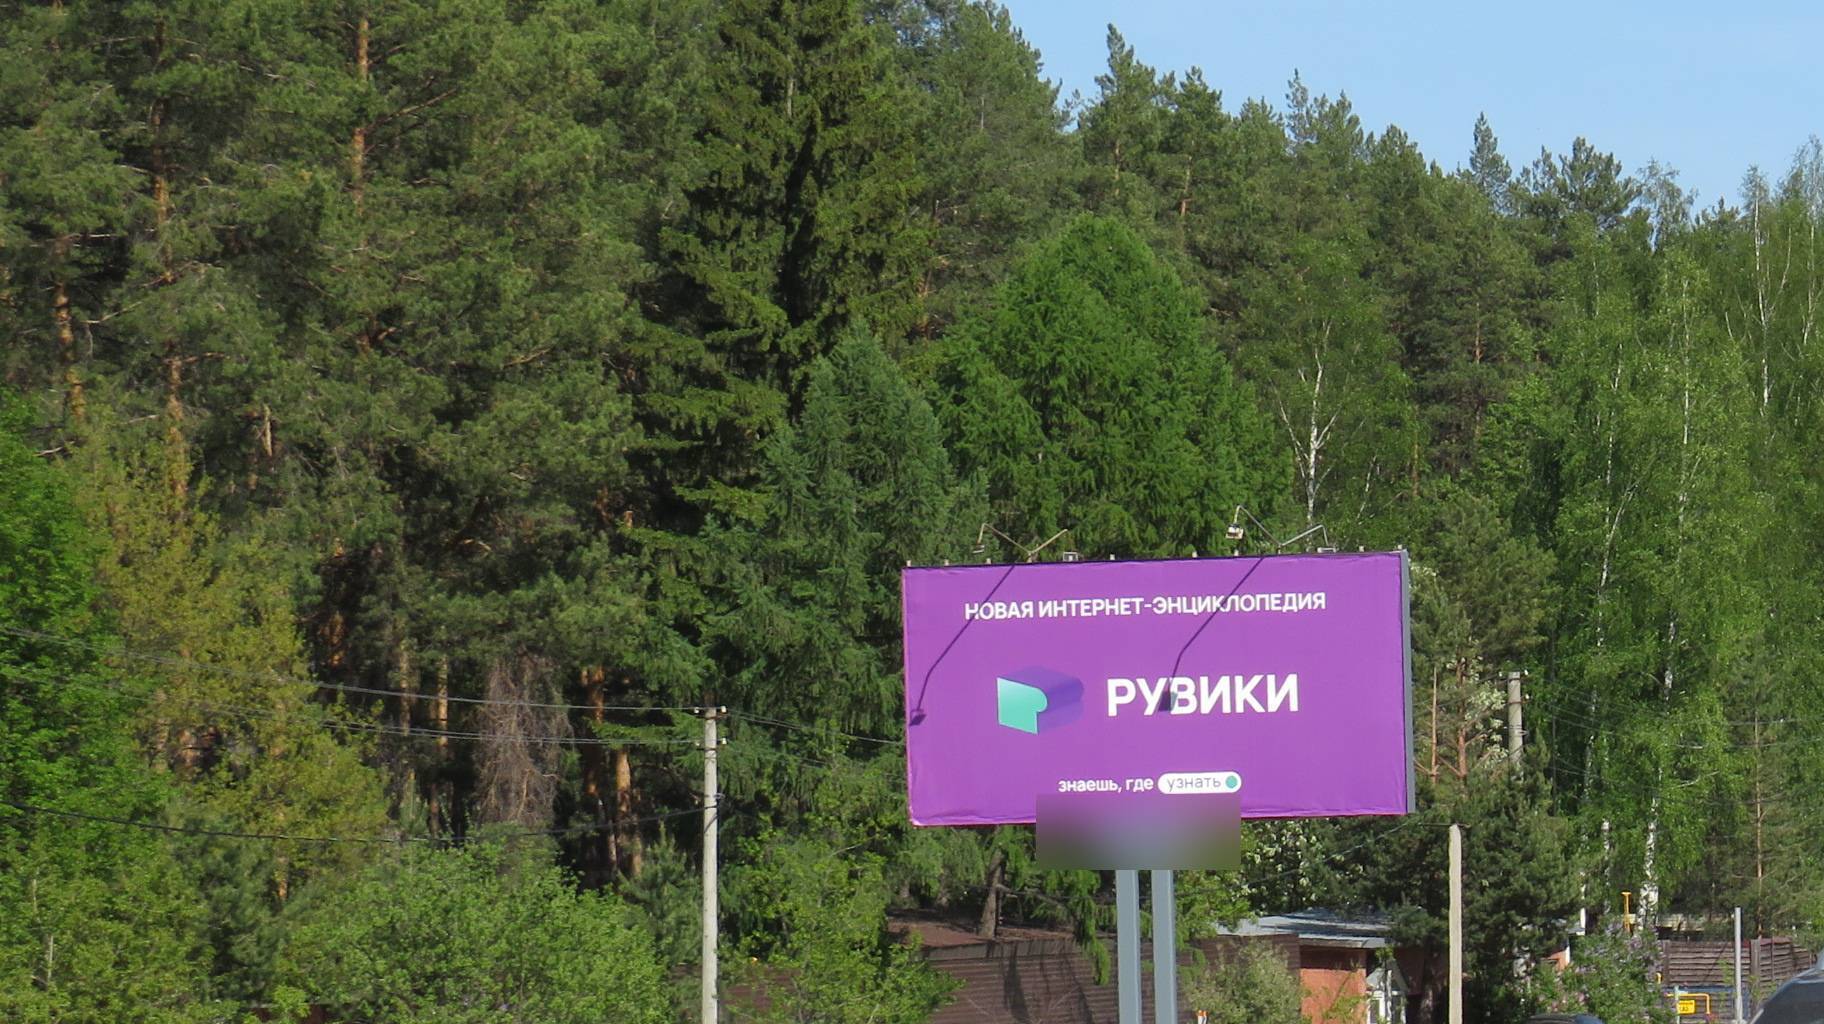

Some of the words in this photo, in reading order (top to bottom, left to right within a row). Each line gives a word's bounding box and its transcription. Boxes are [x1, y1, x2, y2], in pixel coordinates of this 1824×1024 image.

[964, 601, 1034, 620] НОВАЯ
[1038, 592, 1327, 618] ИНТЕРНЕТ-ЭНЦИКЛОПЕДИЯ
[1106, 673, 1300, 717] РУВИКИ
[1057, 778, 1122, 793] знаешь,
[1125, 777, 1154, 792] где
[1166, 776, 1221, 792] узнать
